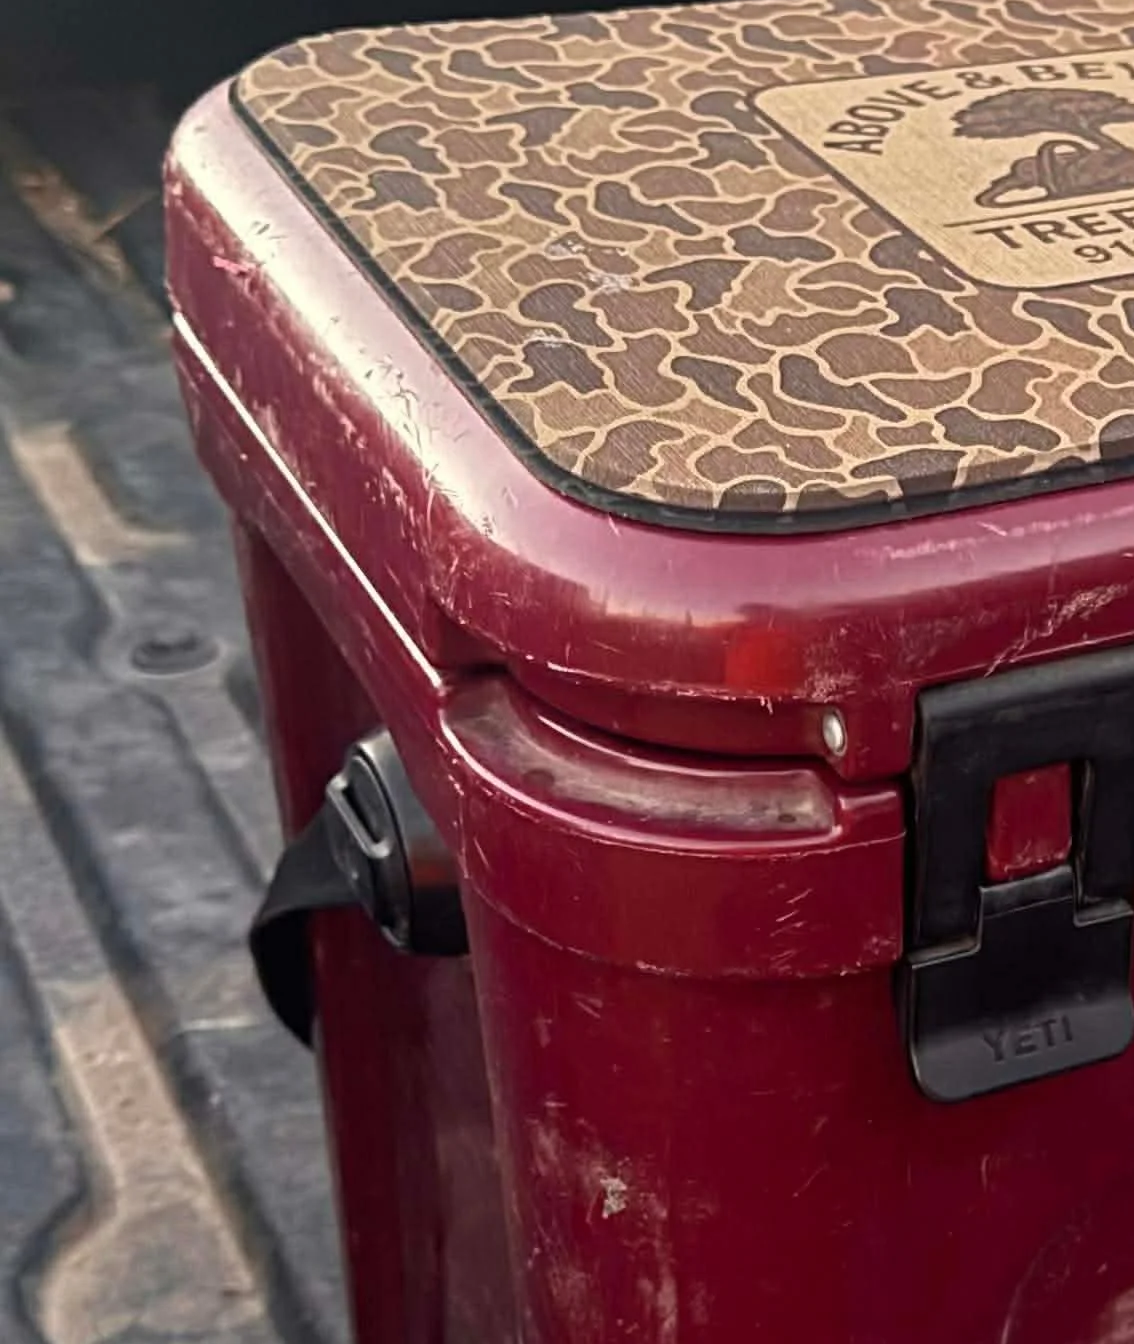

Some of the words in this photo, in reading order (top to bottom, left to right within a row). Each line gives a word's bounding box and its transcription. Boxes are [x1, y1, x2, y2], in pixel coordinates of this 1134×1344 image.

[823, 77, 960, 157] ABOVE
[956, 70, 1003, 90] &
[981, 1014, 1074, 1063] YETI
